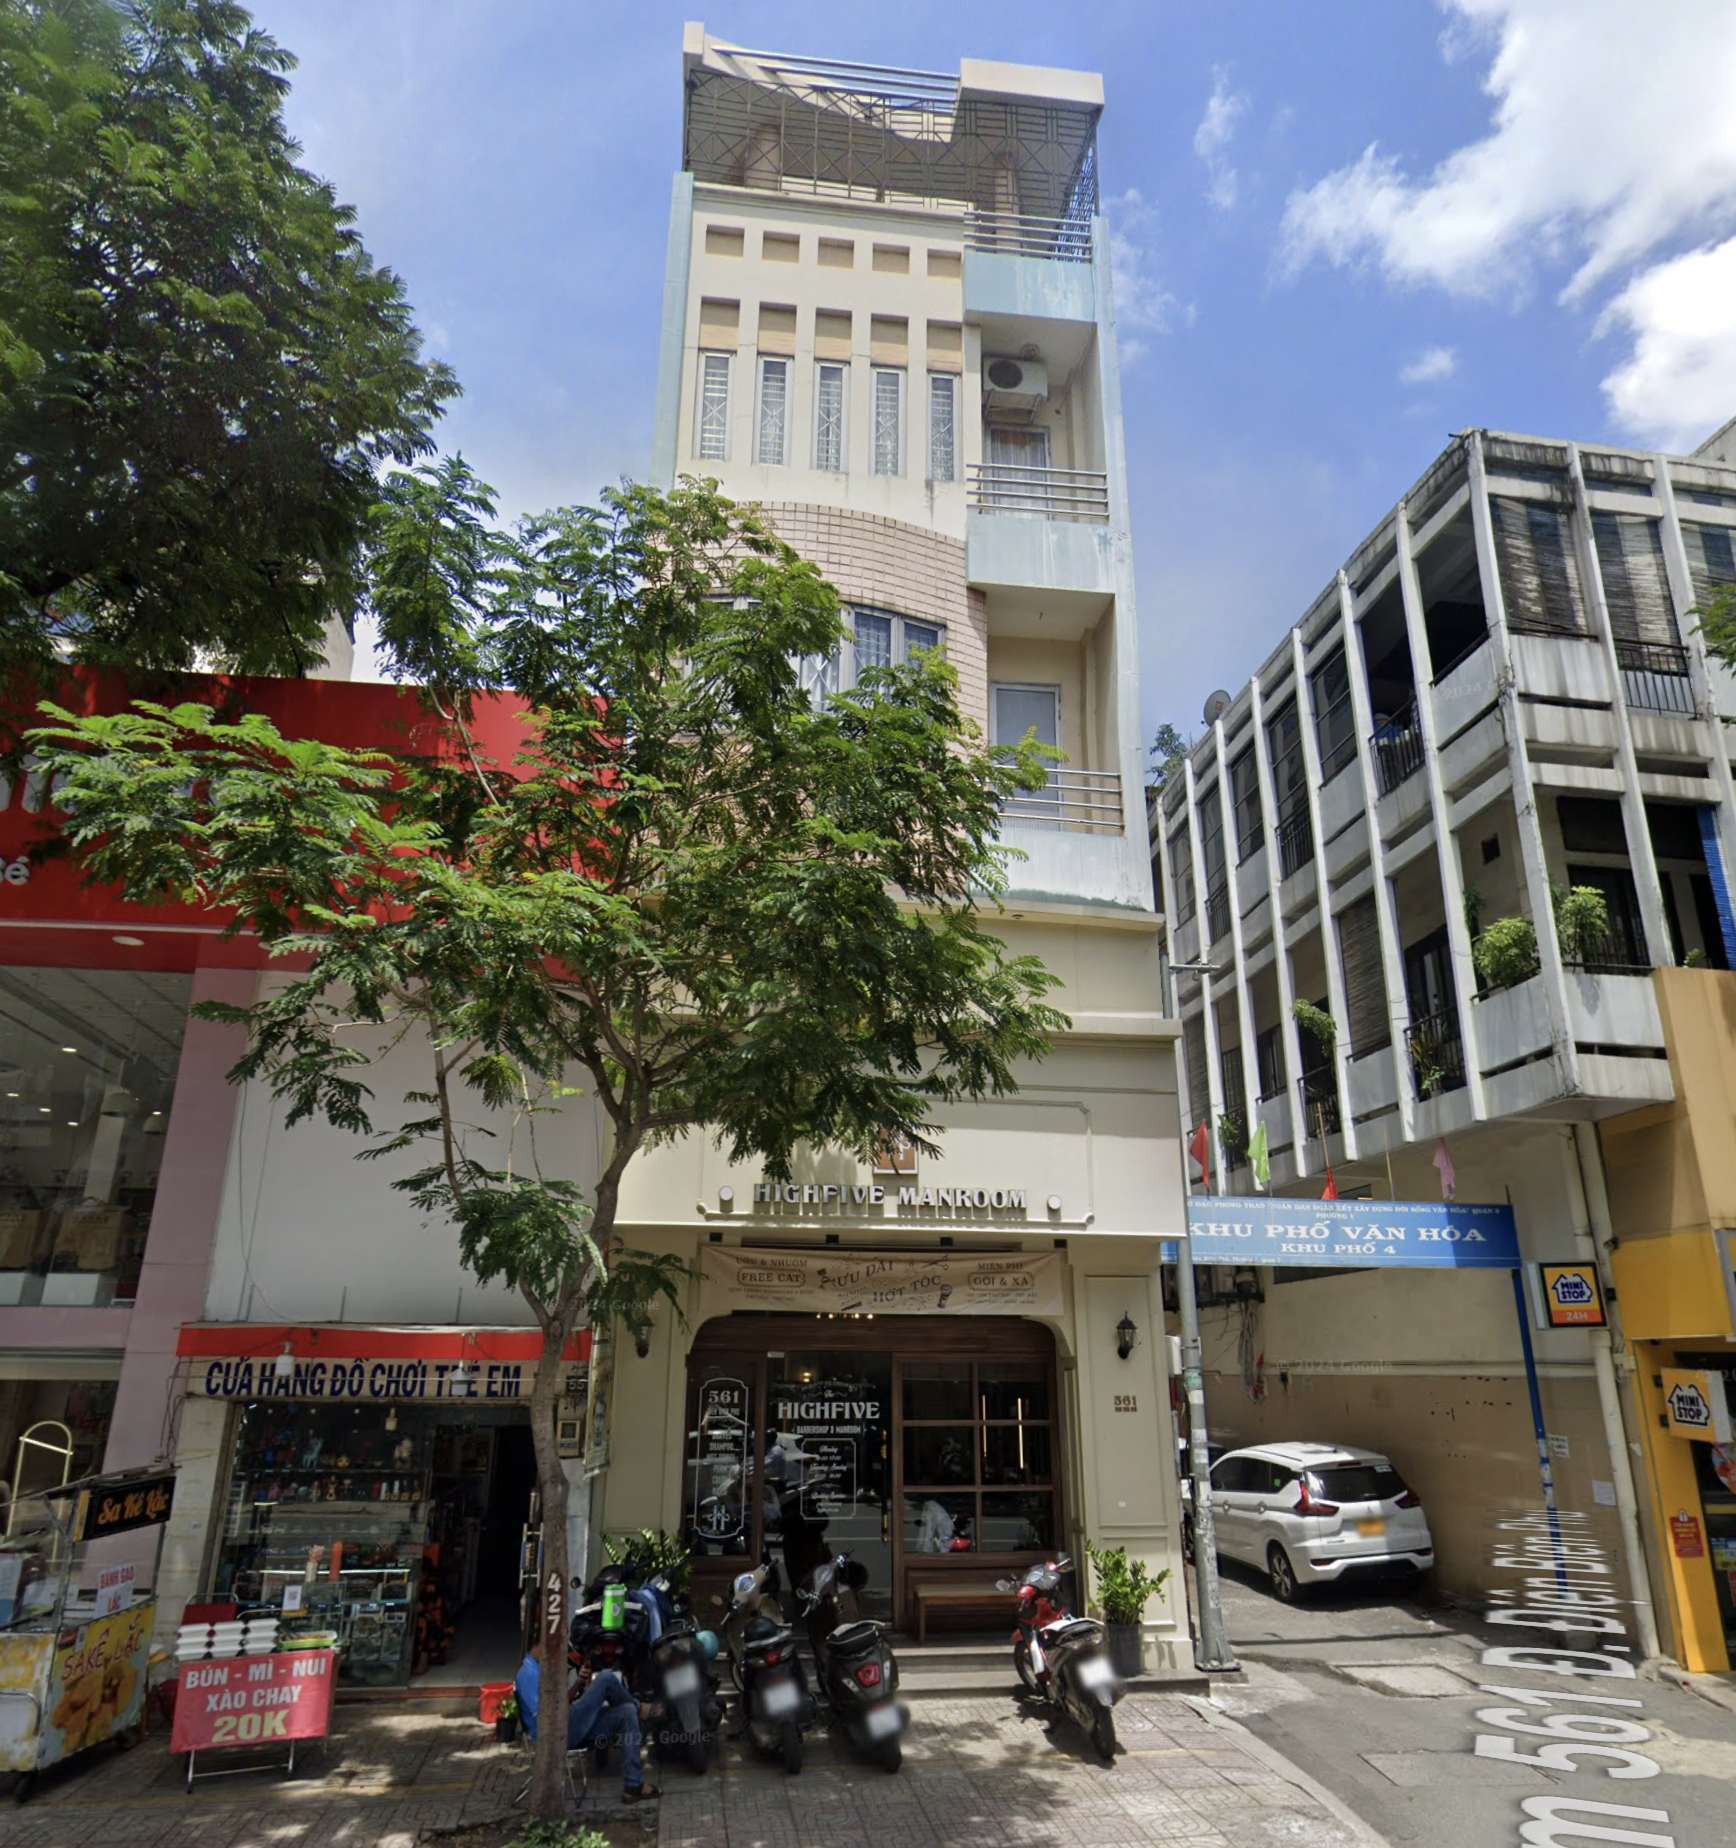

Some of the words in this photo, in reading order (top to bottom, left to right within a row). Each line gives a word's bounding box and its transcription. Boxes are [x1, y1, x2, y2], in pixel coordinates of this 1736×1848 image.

[754, 1183, 884, 1204] HIGHFIVE
[898, 1186, 1027, 1208] MANROOM
[1265, 1220, 1331, 1239] PHỐ
[1341, 1224, 1406, 1241] VĂN
[1417, 1225, 1487, 1242] HÓA
[1281, 1242, 1327, 1254] KHU
[1334, 1241, 1376, 1254] PHỐ
[1384, 1245, 1397, 1255] 4
[741, 1272, 774, 1282] FREE
[778, 1272, 801, 1283] CAT
[999, 1276, 1007, 1286] &
[1561, 1281, 1584, 1290] MINI
[1561, 1290, 1586, 1300] STOP
[329, 1357, 365, 1397] ĐỒ
[369, 1358, 427, 1398] CHƠI
[486, 1364, 521, 1398] EM
[708, 1390, 739, 1404] 561
[1114, 1395, 1137, 1406] 561
[1676, 1394, 1700, 1408] MINI
[777, 1402, 880, 1419] HIGHFIVE
[1677, 1406, 1703, 1420] STOP
[98, 1498, 122, 1525] Sa
[547, 1573, 561, 1634] 427
[186, 1665, 228, 1690] BÚN
[248, 1659, 274, 1682] MÌ
[292, 1657, 326, 1678] NUI
[205, 1689, 247, 1712] XÀO
[252, 1685, 302, 1707] CHAY
[211, 1709, 290, 1743] 20K
